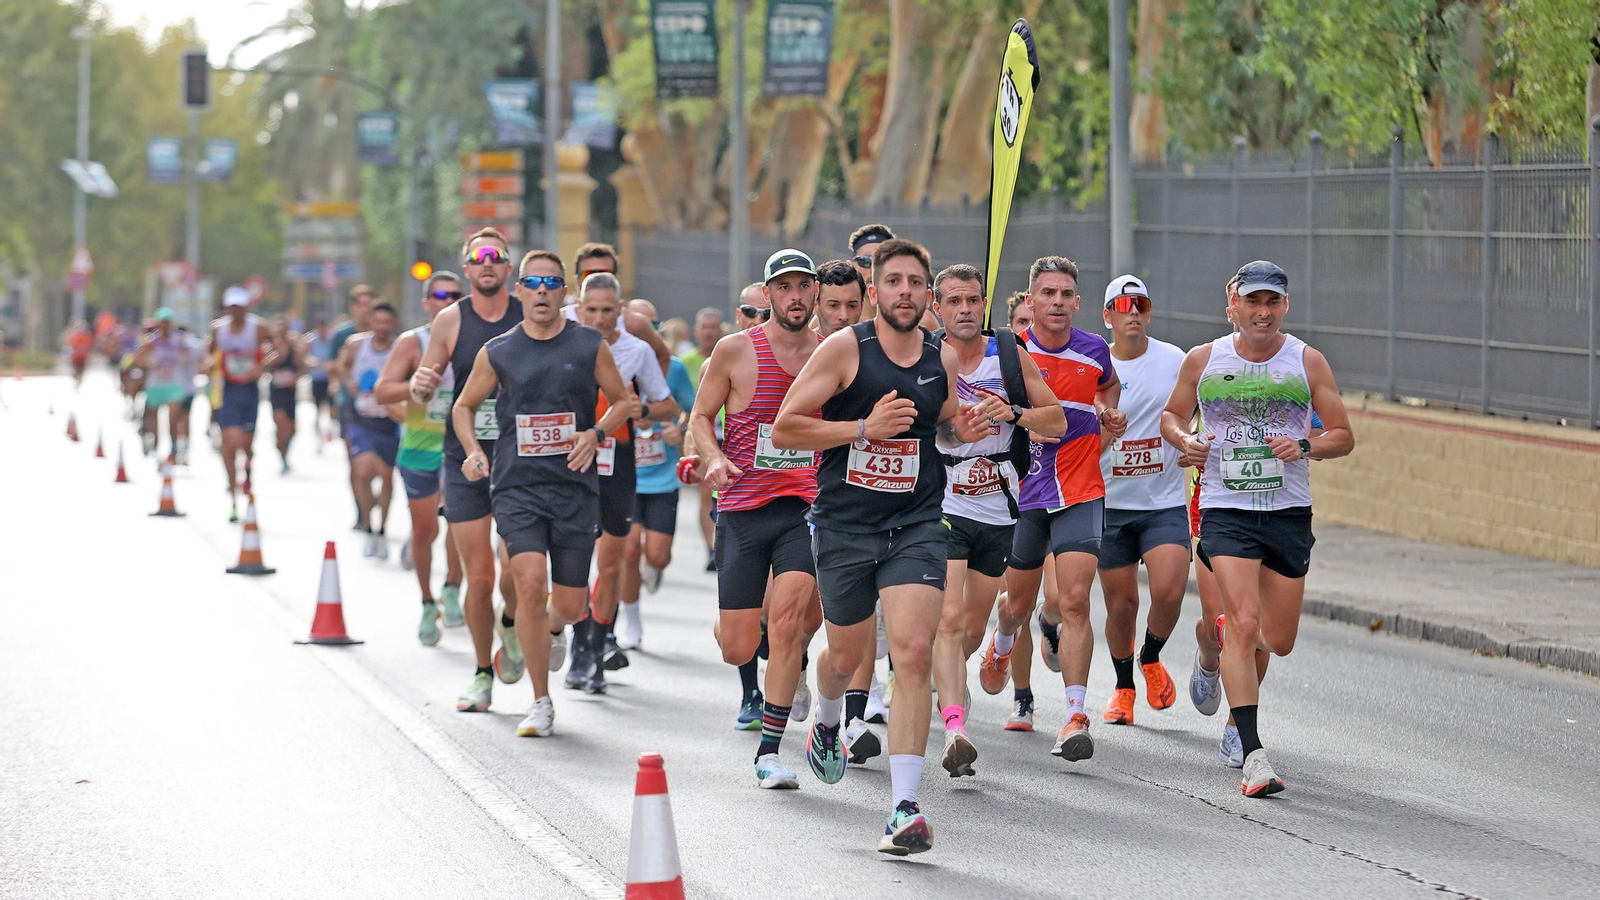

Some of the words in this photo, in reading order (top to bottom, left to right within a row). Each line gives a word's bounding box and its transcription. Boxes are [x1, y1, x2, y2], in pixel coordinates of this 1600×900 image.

[532, 428, 561, 442] 538
[1224, 425, 1243, 444] Los
[865, 455, 904, 475] 433
[1124, 451, 1152, 465] 278
[967, 464, 998, 484] 584
[1241, 461, 1263, 477] 40
